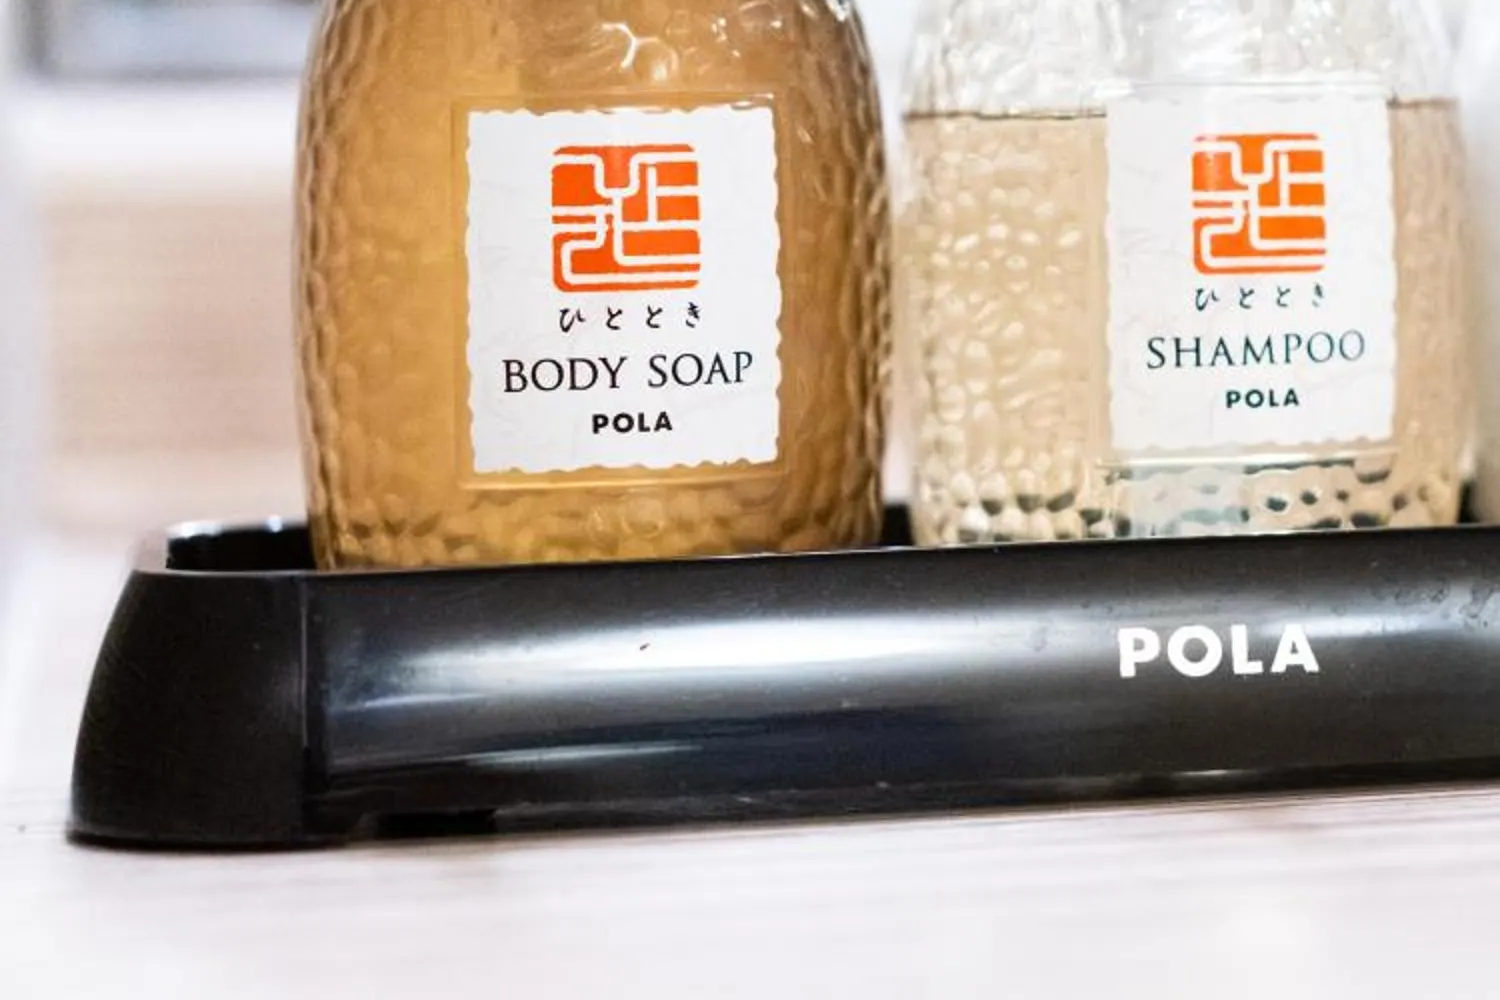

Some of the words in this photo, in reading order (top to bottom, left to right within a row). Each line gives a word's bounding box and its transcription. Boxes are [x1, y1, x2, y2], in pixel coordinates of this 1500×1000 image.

[559, 301, 701, 333] ひととき
[1146, 329, 1366, 370] SHAMPOO
[502, 356, 628, 393] BODY
[647, 350, 753, 388] SOAP
[1225, 388, 1300, 409] POLA
[591, 411, 673, 434] POLA
[1117, 623, 1321, 679] POLA
